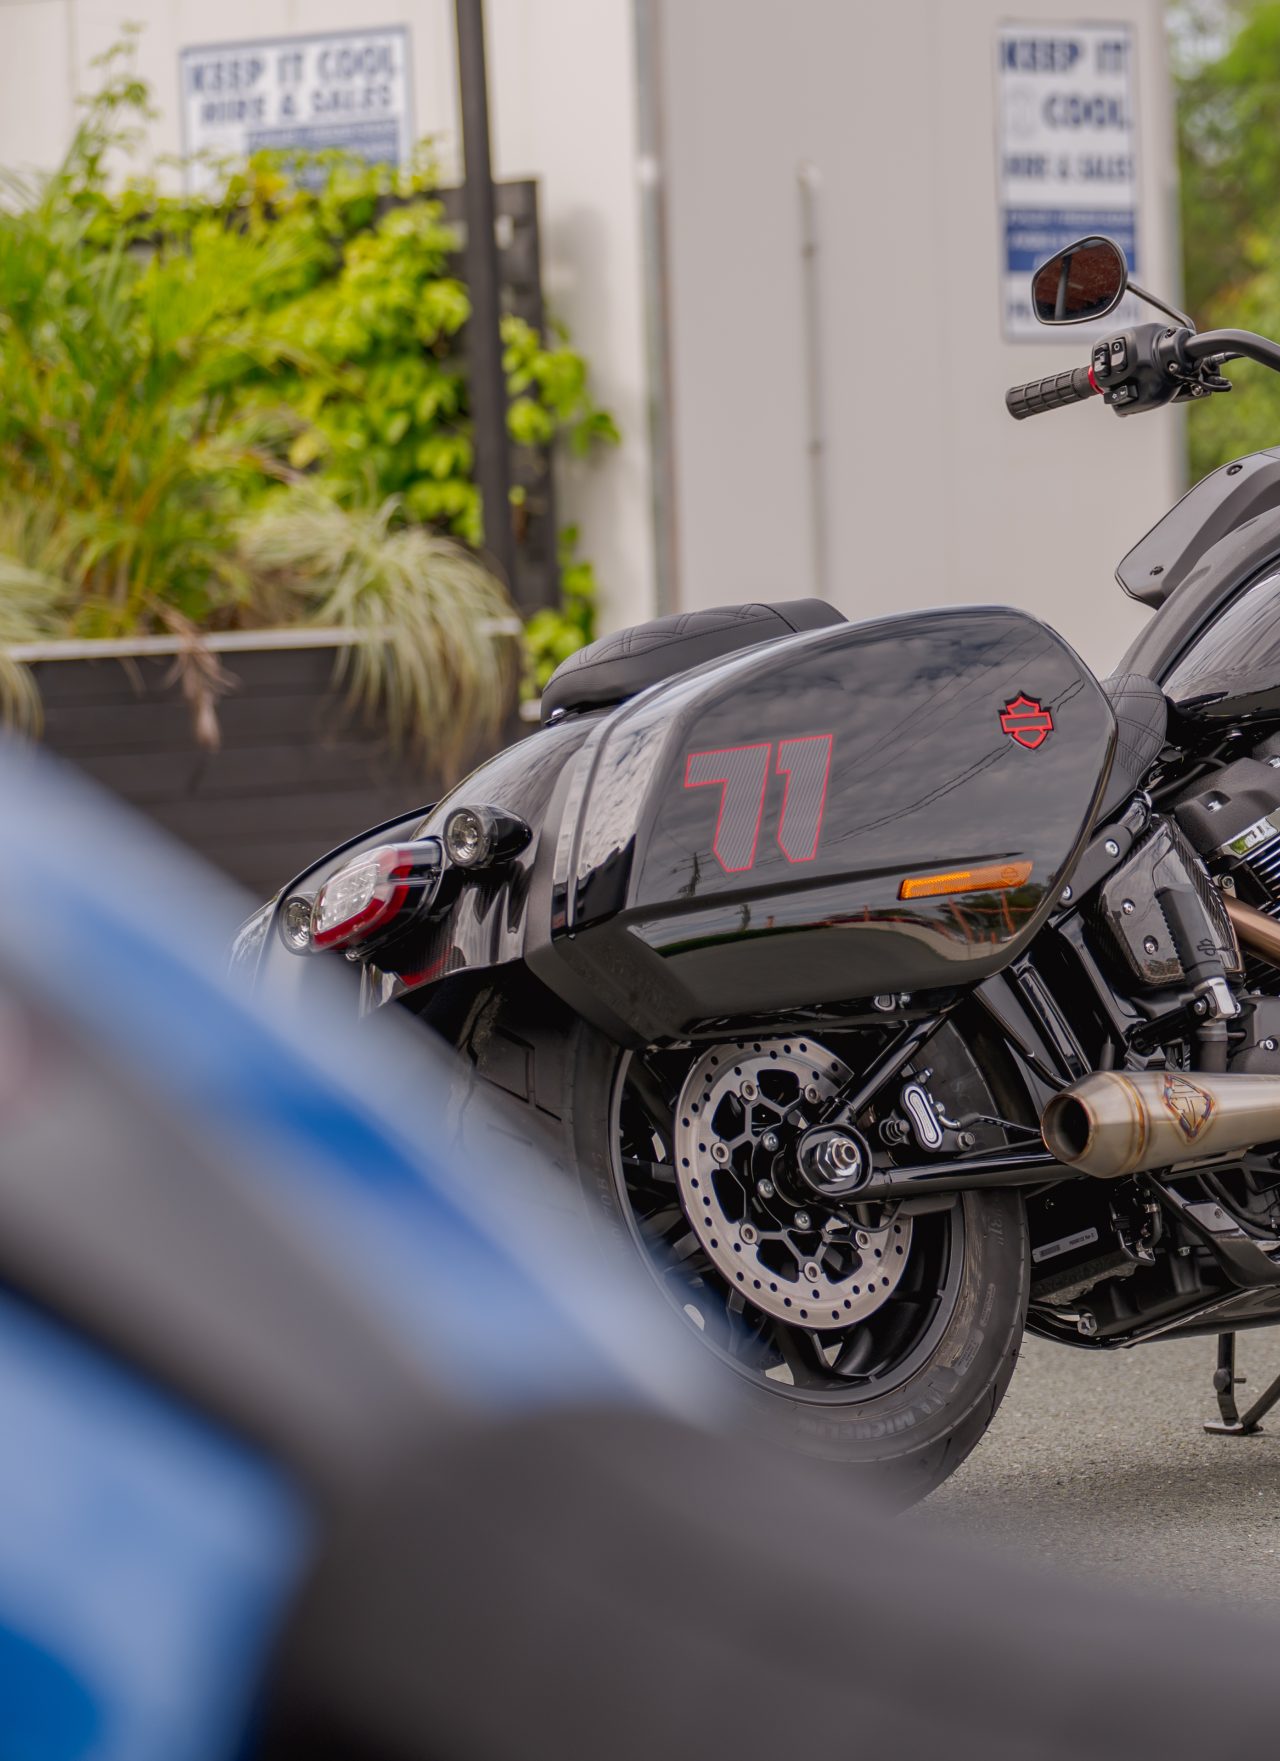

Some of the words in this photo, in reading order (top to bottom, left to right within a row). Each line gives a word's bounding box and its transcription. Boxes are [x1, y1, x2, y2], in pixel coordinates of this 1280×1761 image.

[190, 57, 264, 91] KEEP
[278, 51, 303, 83] IT
[318, 44, 395, 80] COOL
[1000, 40, 1079, 71] KEEP
[1096, 39, 1130, 72] IT
[203, 95, 265, 122] HIRE
[311, 84, 391, 112] SALES
[1042, 95, 1133, 130] COOL
[684, 735, 833, 872] 71
